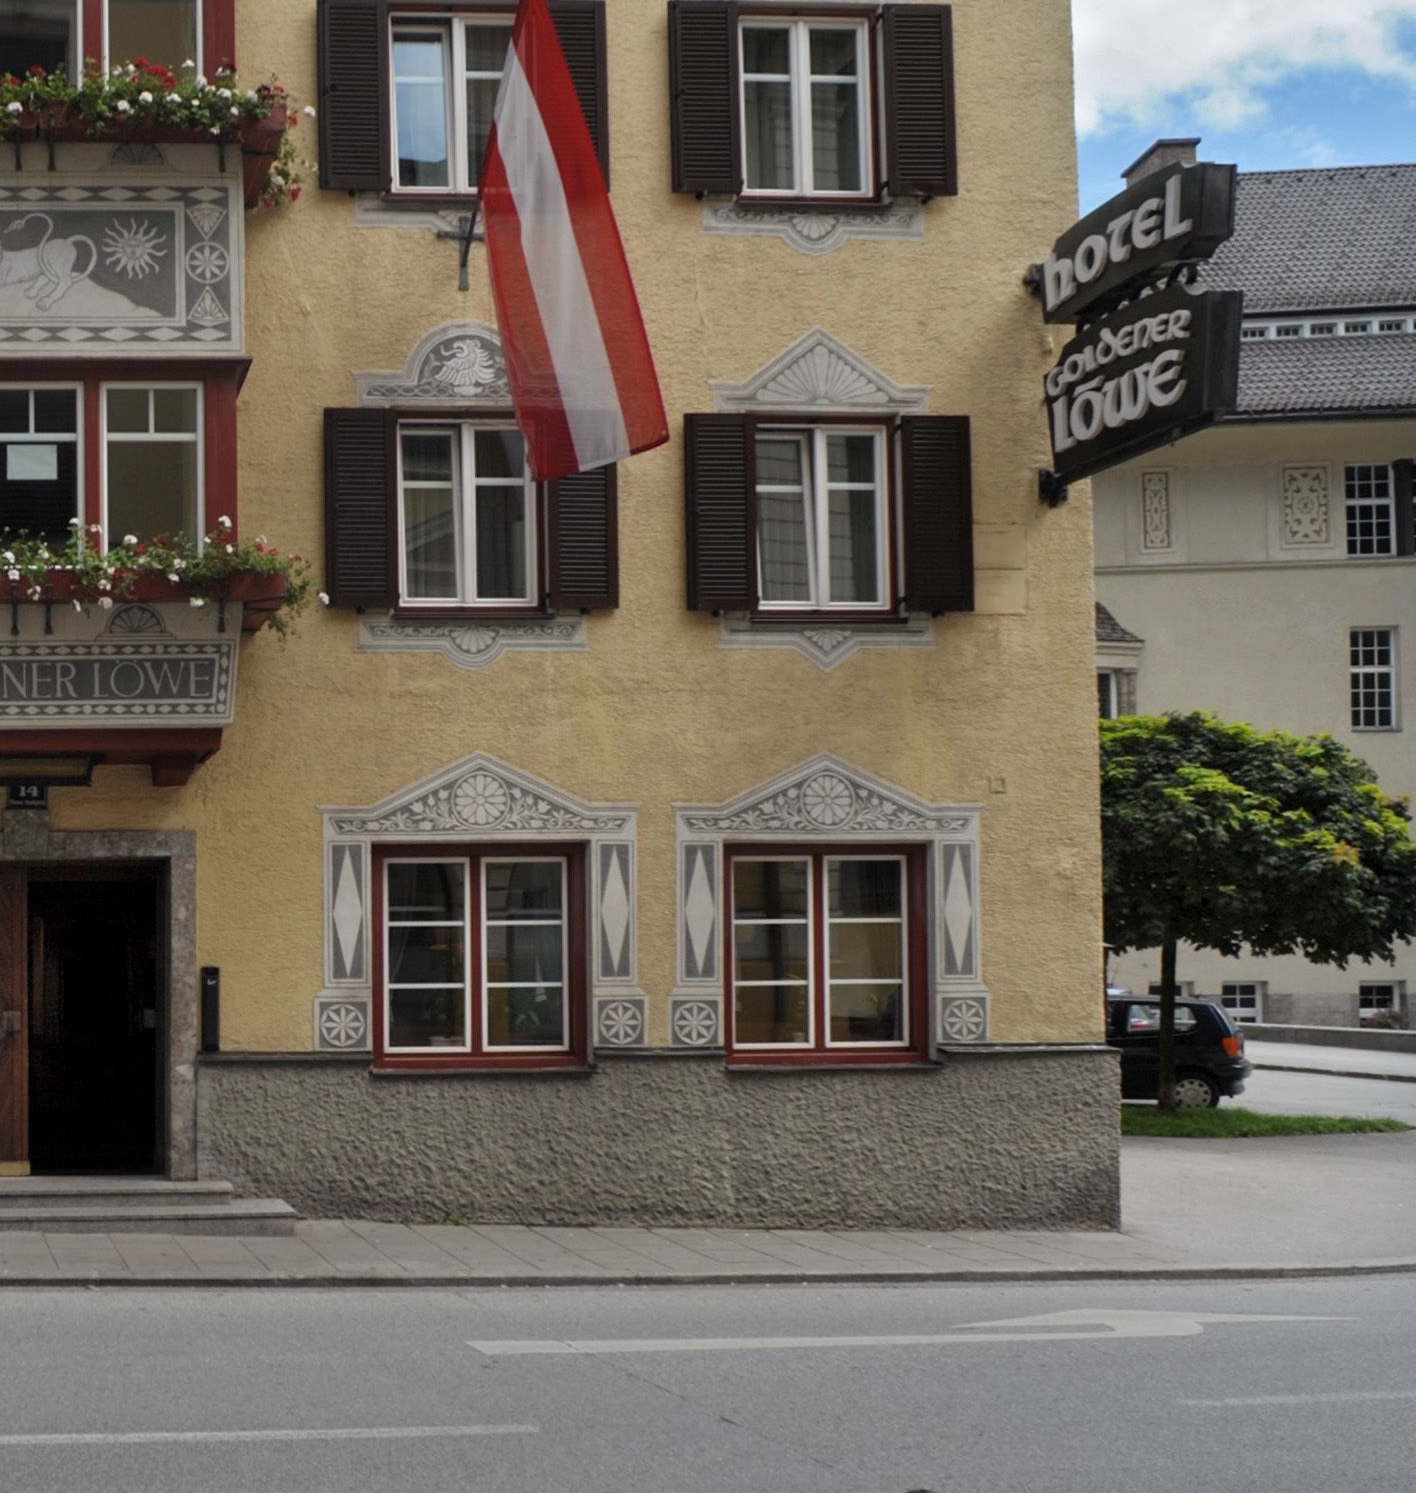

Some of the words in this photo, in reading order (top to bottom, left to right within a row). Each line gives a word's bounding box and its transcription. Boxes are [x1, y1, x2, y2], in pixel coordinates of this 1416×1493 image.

[1043, 174, 1192, 312] HOTEL
[1046, 309, 1192, 397] GOLDENER
[93, 658, 211, 699] LÖWE
[18, 785, 39, 797] 14
